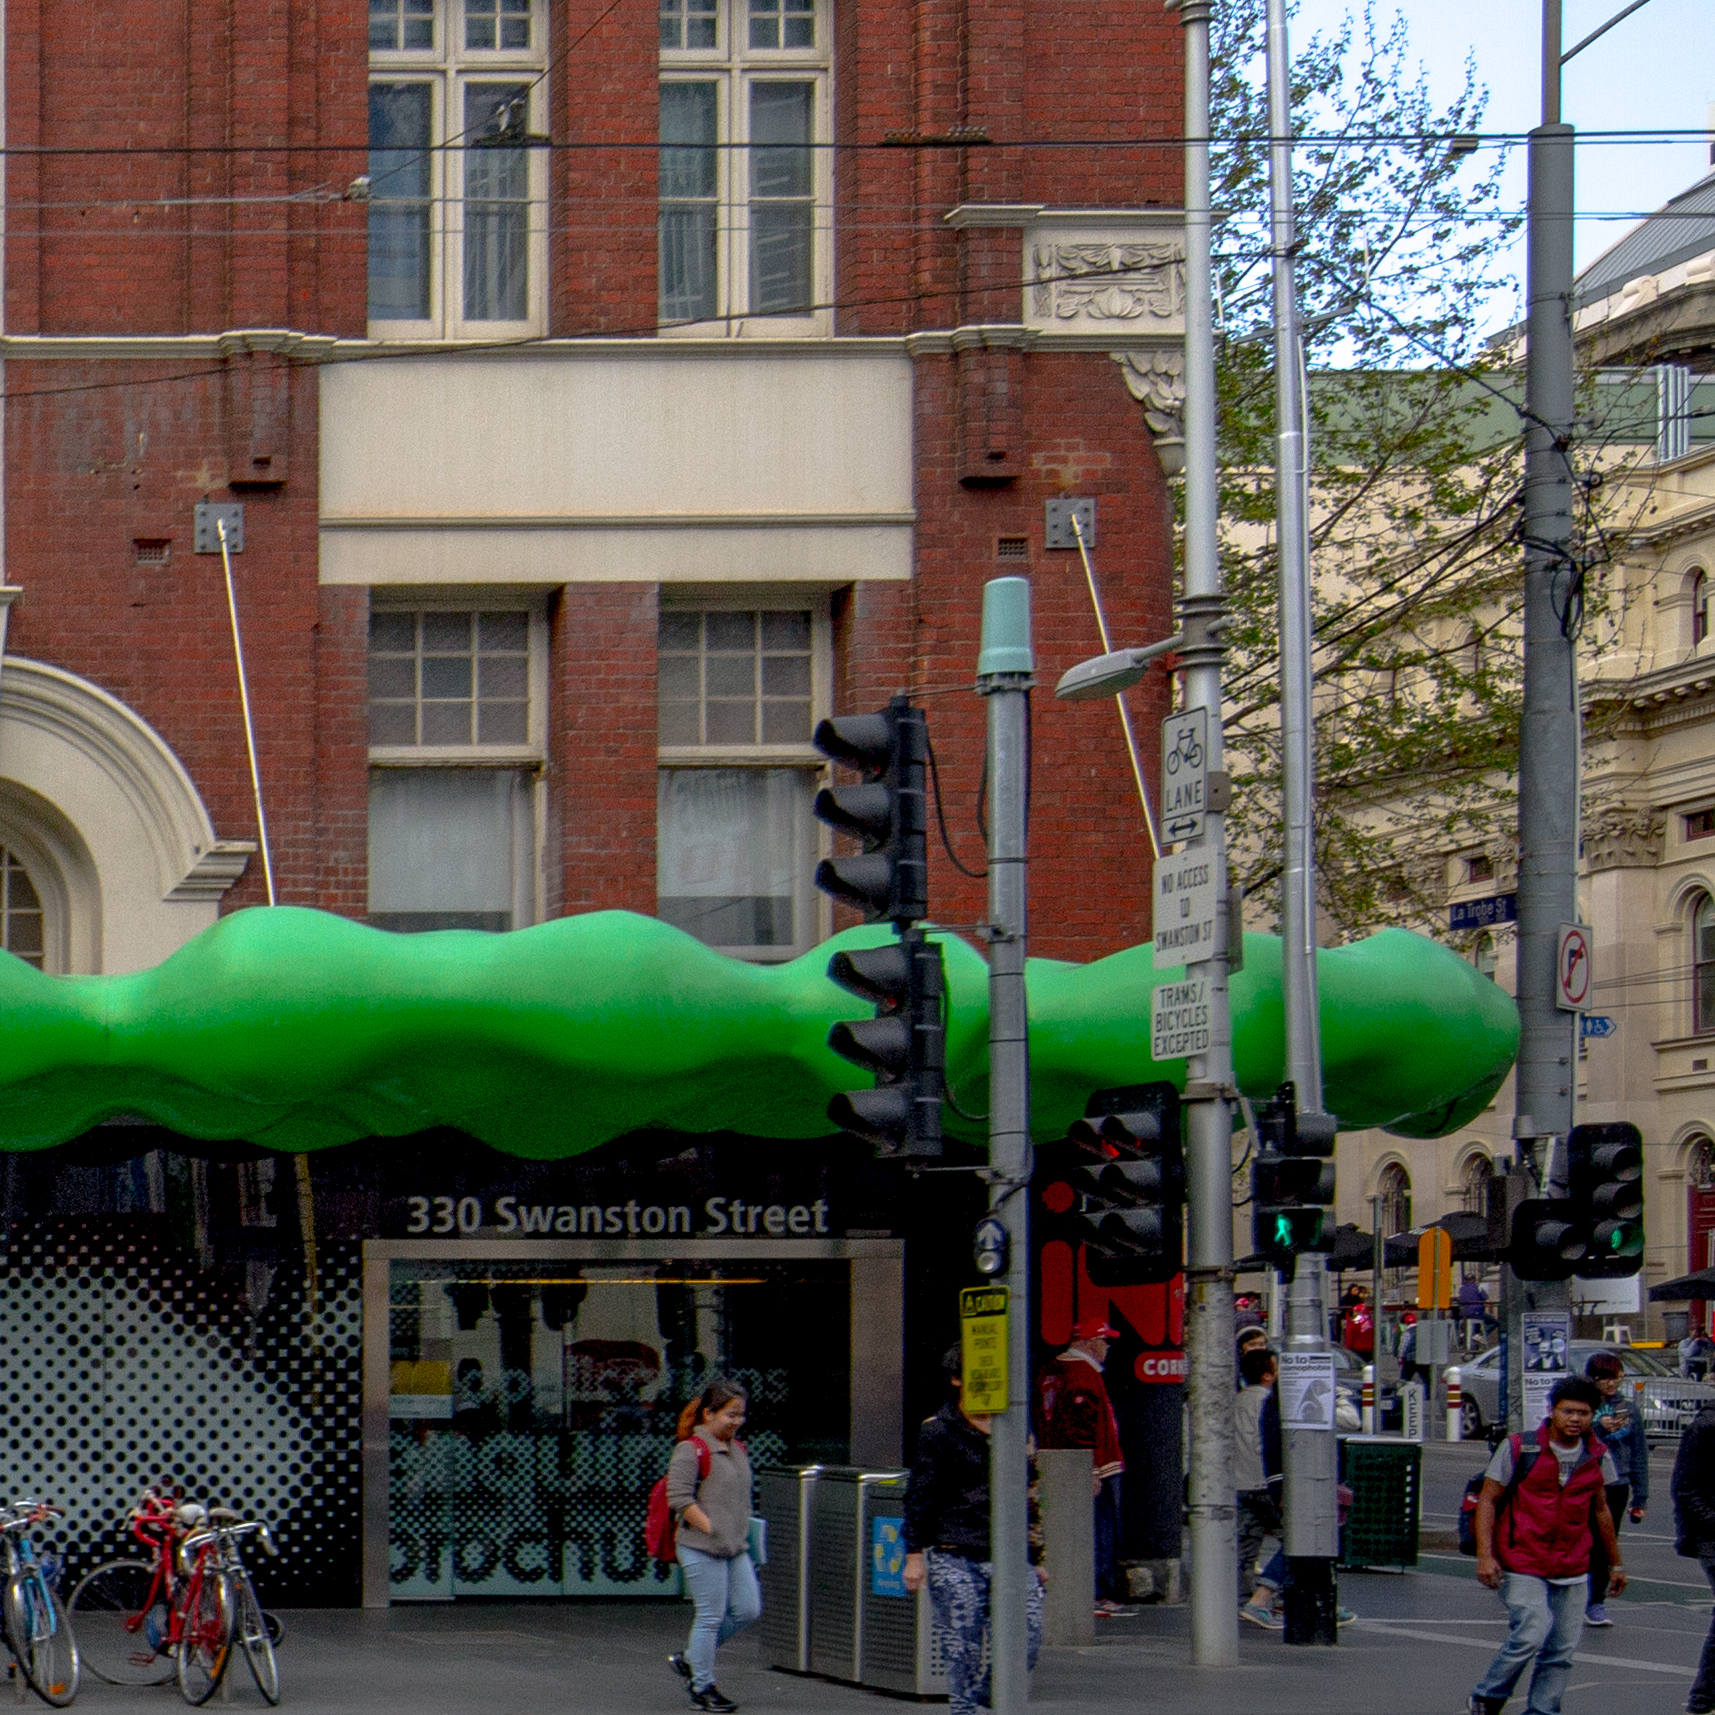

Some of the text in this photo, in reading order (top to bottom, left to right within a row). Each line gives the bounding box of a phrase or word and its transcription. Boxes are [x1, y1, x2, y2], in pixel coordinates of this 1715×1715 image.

[1166, 778, 1203, 814] LANE
[1161, 864, 1210, 896] NO ACCESS
[1179, 896, 1191, 920] TO
[1453, 904, 1465, 922] La
[1466, 900, 1495, 919] Trobe
[1495, 896, 1507, 916] St
[1155, 919, 1214, 955] SWANSTON ST
[1159, 982, 1205, 1010] TRAMS/
[1155, 1004, 1209, 1035] BICYCLES
[1153, 1027, 1210, 1060] EXCEPTED
[405, 1194, 831, 1236] 330 Swanston Street
[1407, 1388, 1418, 1440] KEEP
